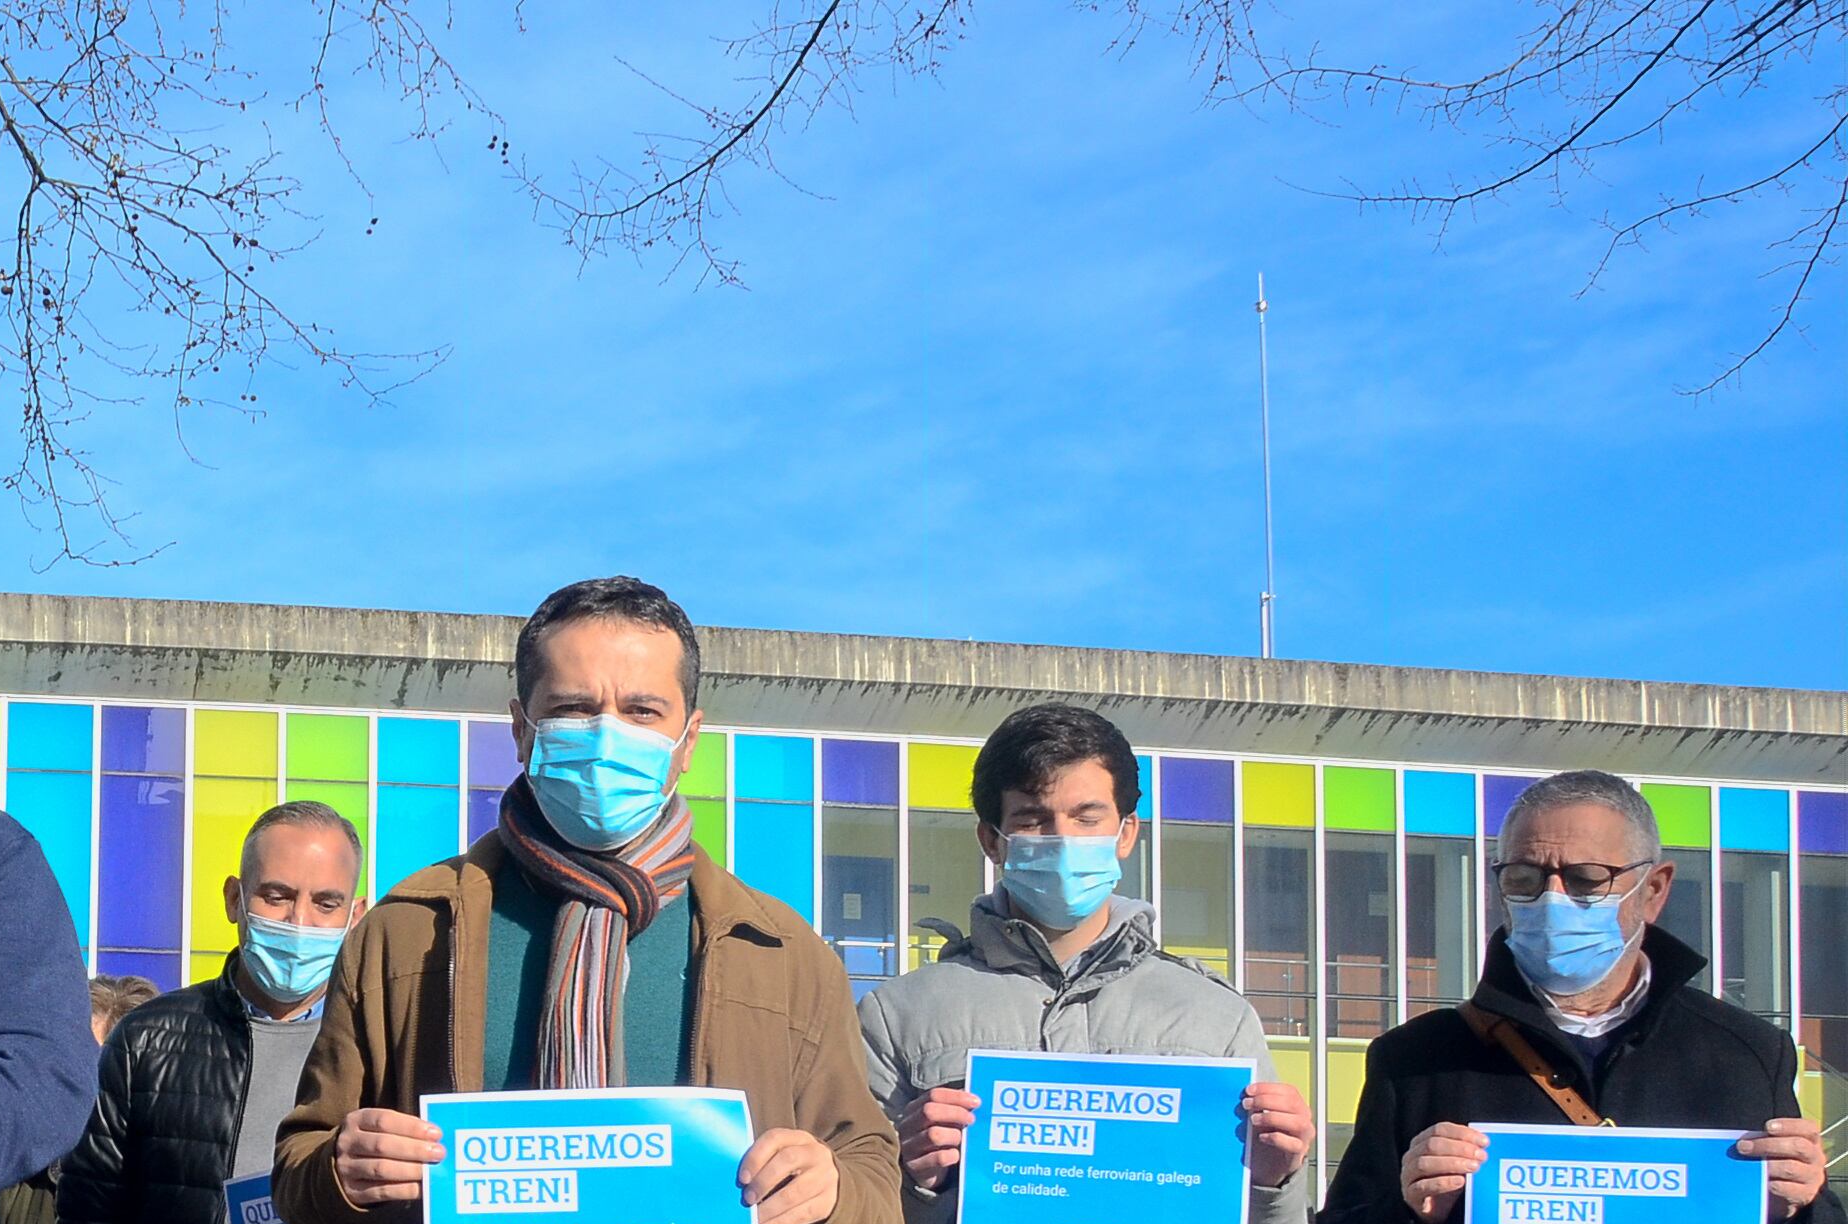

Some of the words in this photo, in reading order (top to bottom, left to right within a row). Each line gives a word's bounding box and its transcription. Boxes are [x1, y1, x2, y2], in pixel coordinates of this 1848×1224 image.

[999, 1087, 1174, 1116] QUEREMOS
[997, 1121, 1089, 1148] TREN!
[463, 1132, 665, 1166] QUEREMOS
[993, 1161, 1016, 1174] Por
[1019, 1163, 1051, 1177] unha
[1054, 1165, 1084, 1178] rede
[1087, 1166, 1153, 1182] ferroviaria
[1156, 1170, 1201, 1187] galega
[1505, 1164, 1681, 1191] QUEREMOS
[463, 1177, 570, 1205] TREN!
[992, 1181, 1008, 1194] de
[1011, 1183, 1070, 1197] calidade.
[1505, 1198, 1597, 1223] TREN!
